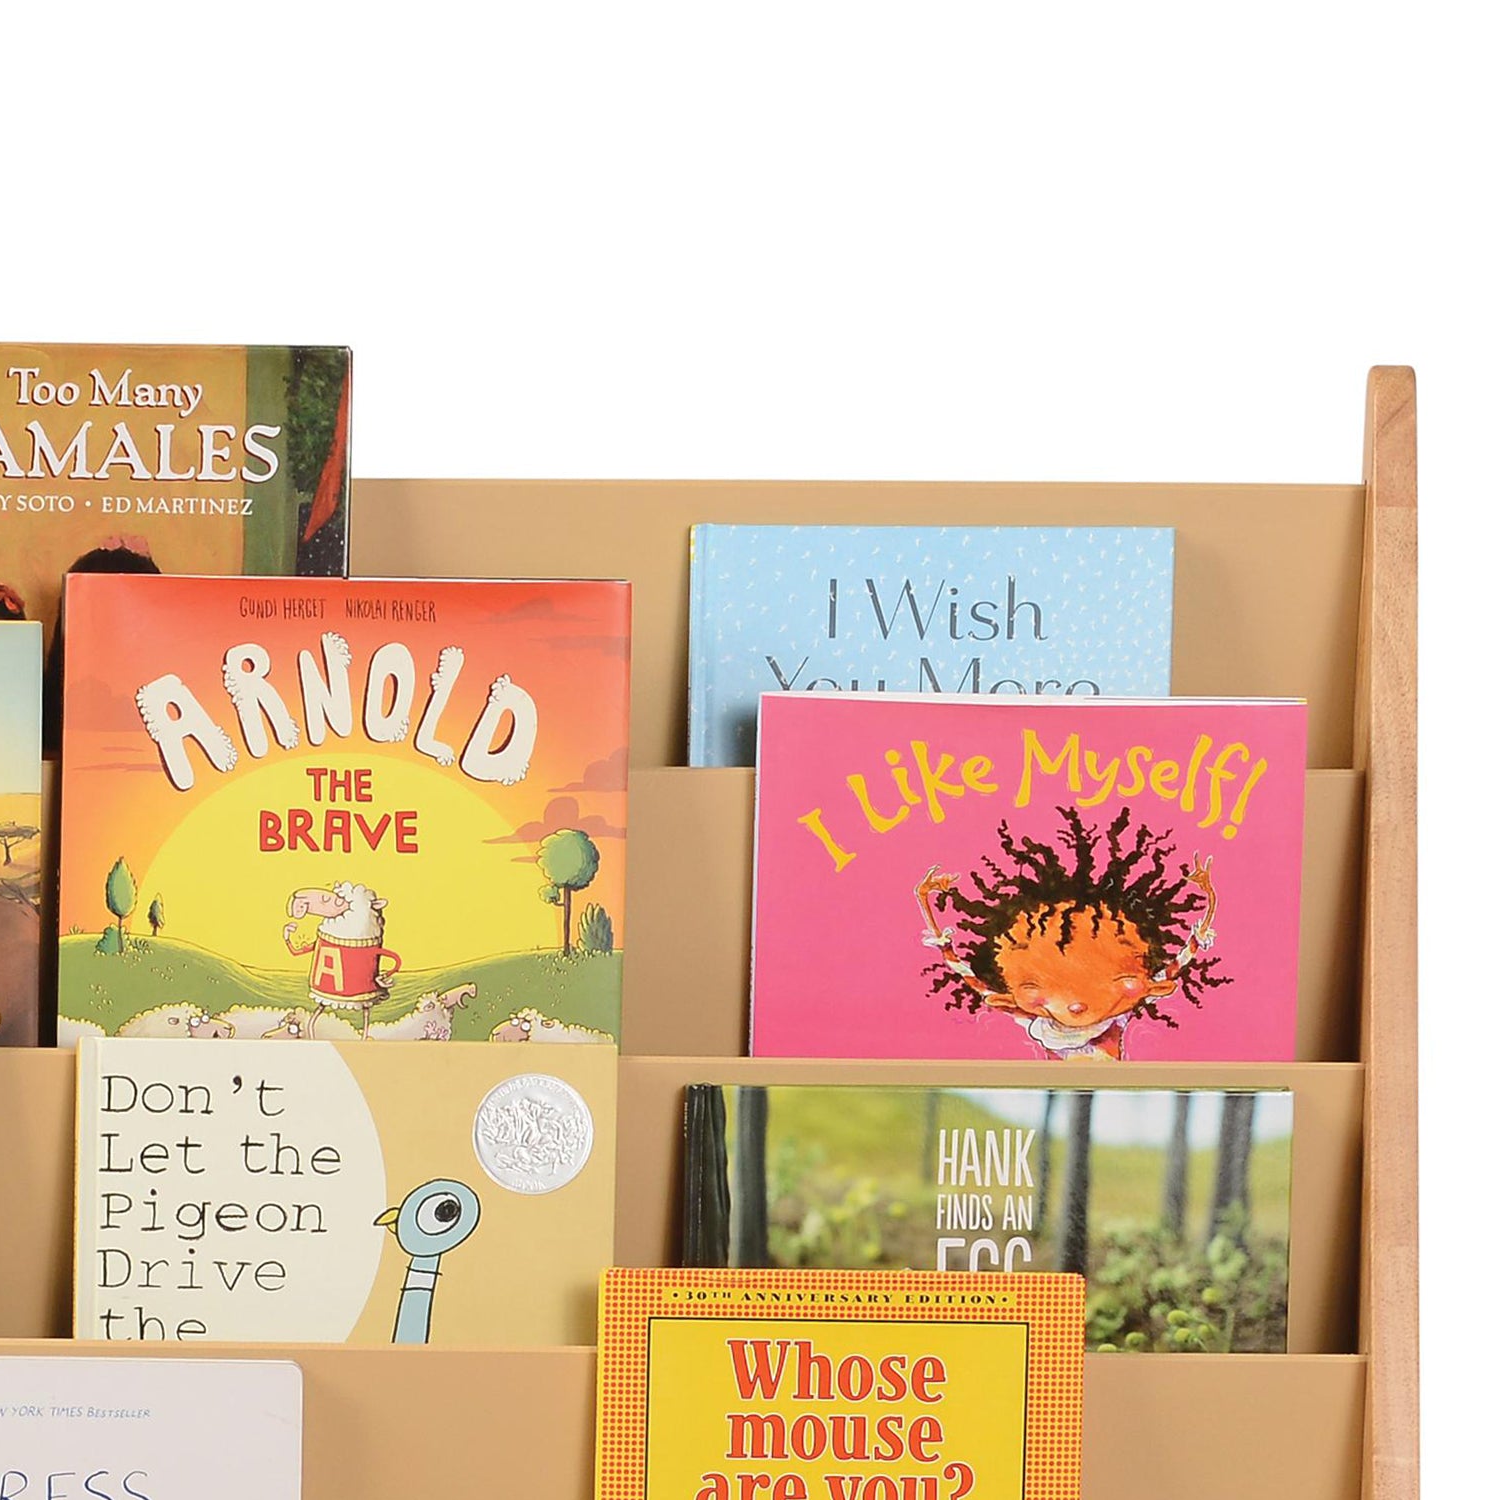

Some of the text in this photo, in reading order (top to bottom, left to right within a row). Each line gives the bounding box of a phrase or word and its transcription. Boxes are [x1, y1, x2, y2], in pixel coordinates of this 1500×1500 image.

[8, 367, 203, 417] Too Many
[16, 495, 75, 513] SOTO
[102, 497, 131, 514] ED
[135, 497, 253, 516] MARTINEZ
[240, 596, 277, 619] GUNDI
[345, 598, 387, 619] NIKOLAI
[392, 600, 436, 622] RENGER
[827, 572, 1050, 642] I Wish
[135, 631, 539, 791] ARNOLD
[306, 767, 374, 803] THE
[797, 728, 1269, 873] I Like Myself!
[258, 810, 419, 855] BRAVE
[101, 1074, 286, 1117] Don't
[99, 1133, 342, 1176] Let the
[937, 1128, 1036, 1188] HANK
[100, 1187, 328, 1240] Pigeon
[936, 1193, 1033, 1231] FINDS AN
[97, 1248, 286, 1292] Drive
[741, 1292, 893, 1304] ANNIVERSARY
[904, 1294, 997, 1305] EDITION
[100, 1307, 206, 1341] the
[726, 1338, 947, 1404] Whose
[12, 1405, 44, 1417] YORK
[50, 1406, 83, 1417] TIMES
[725, 1412, 945, 1464] mouse
